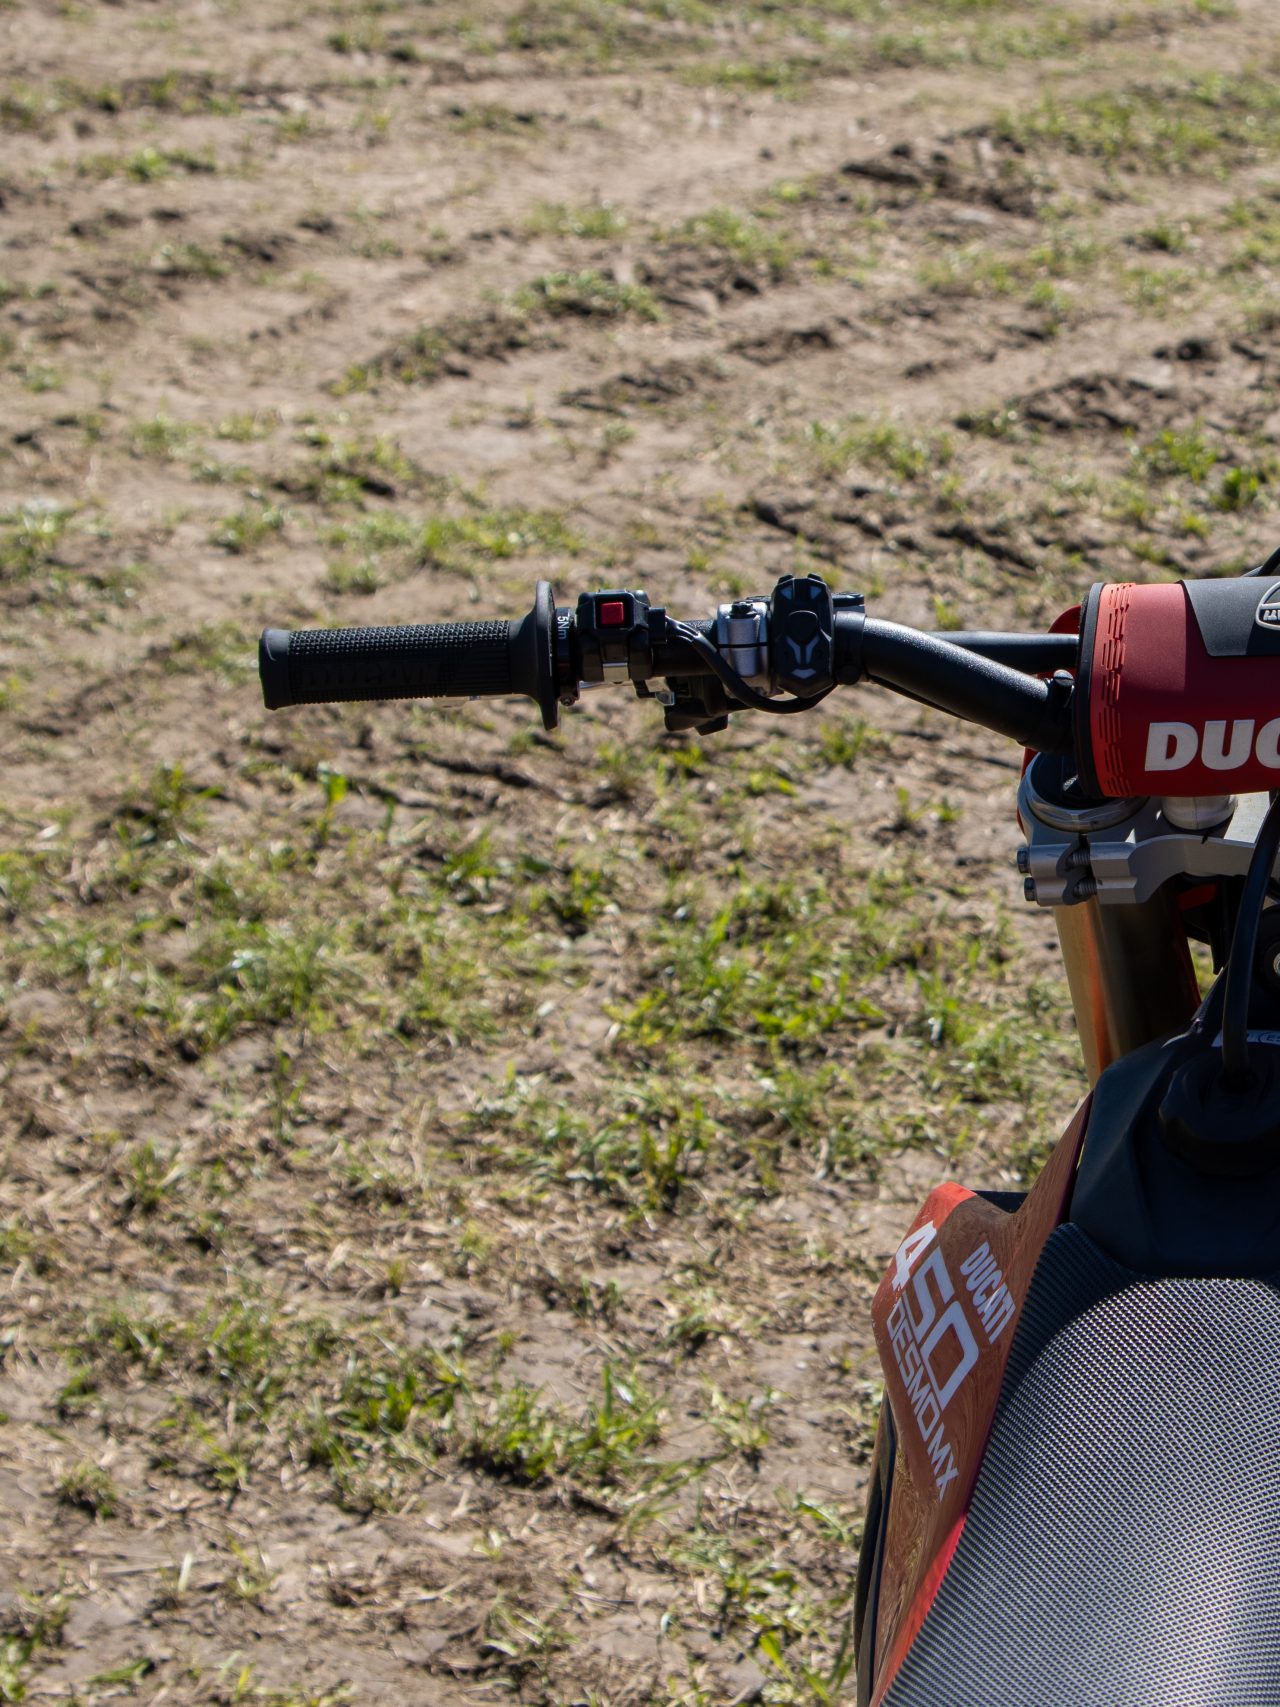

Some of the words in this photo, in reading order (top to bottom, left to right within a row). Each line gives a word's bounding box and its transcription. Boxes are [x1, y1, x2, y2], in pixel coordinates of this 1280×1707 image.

[557, 615, 570, 639] 5Nm
[892, 1220, 979, 1411] 450
[959, 1241, 1016, 1344] DUCATI
